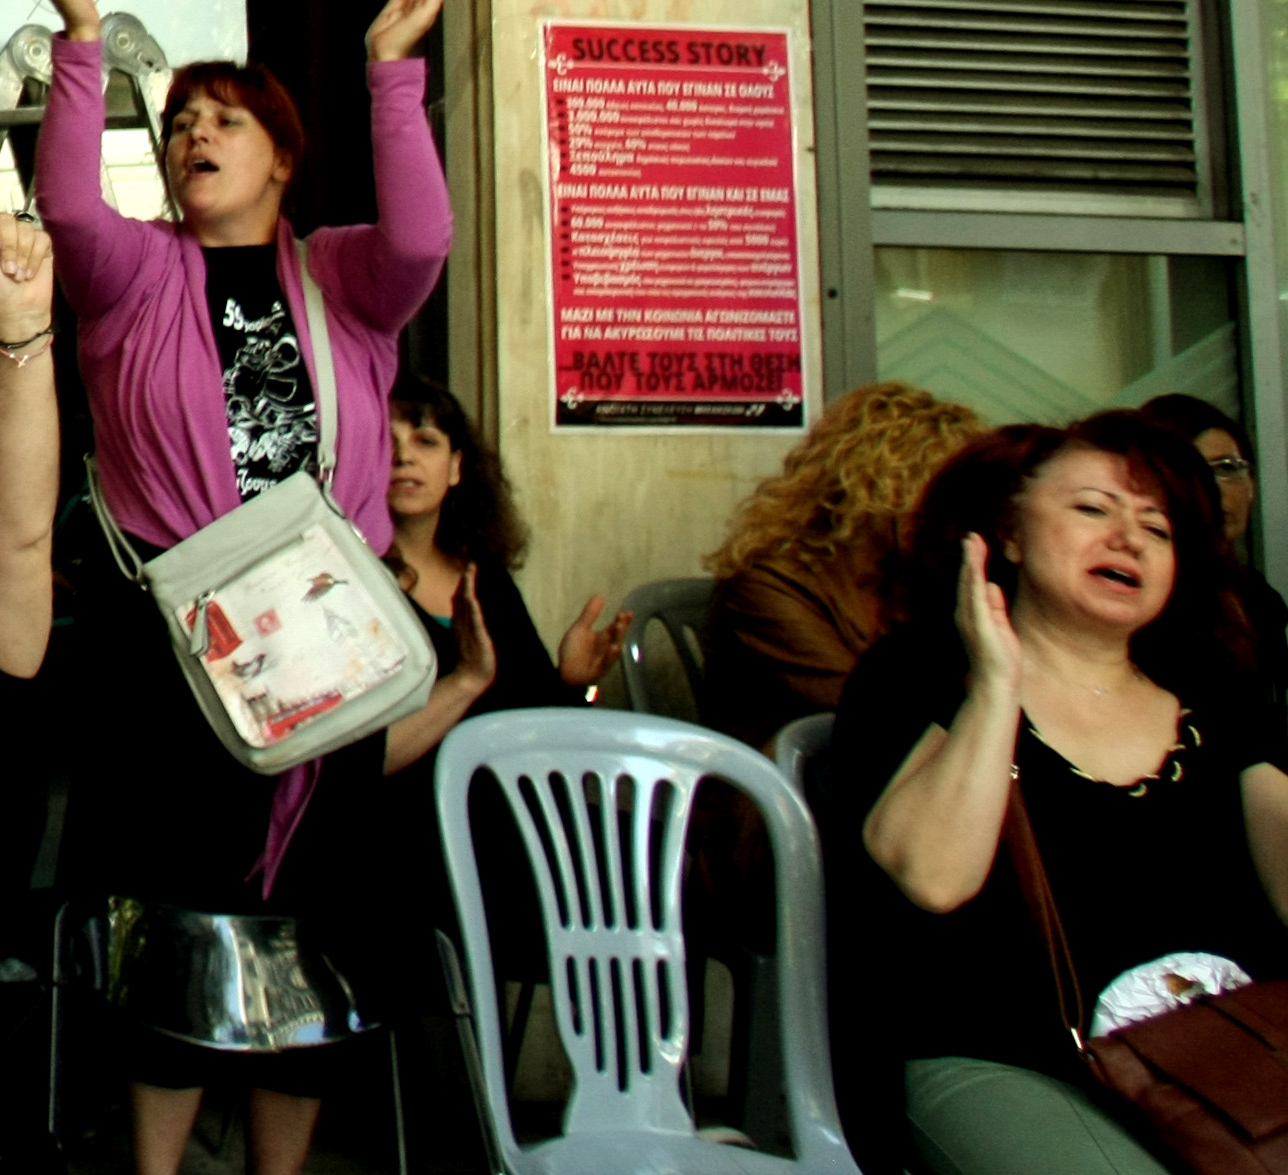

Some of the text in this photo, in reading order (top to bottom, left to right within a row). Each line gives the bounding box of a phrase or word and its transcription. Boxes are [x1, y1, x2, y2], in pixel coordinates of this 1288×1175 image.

[573, 38, 767, 66] SUCCESS STORY
[586, 79, 625, 94] ΠΟΛΛΑ
[627, 80, 656, 95] ΑΥΤΑ
[658, 81, 682, 96] ΠΟΥ
[589, 184, 629, 199] ΠΟΛΛΑ
[630, 184, 660, 200] ΑΥΤΑ
[661, 185, 685, 201] ΠΟΥ
[561, 325, 582, 340] ΓΙΑ
[584, 326, 602, 340] ΝΑ
[647, 352, 699, 372] ΤΟΥΣ
[704, 352, 744, 373] ΣΤΗ
[749, 353, 801, 373] ΘΕΣΗ
[579, 372, 784, 392] ΠΟΥ ΤΟΥΣ ΑΡΜΟΖΕΙ
